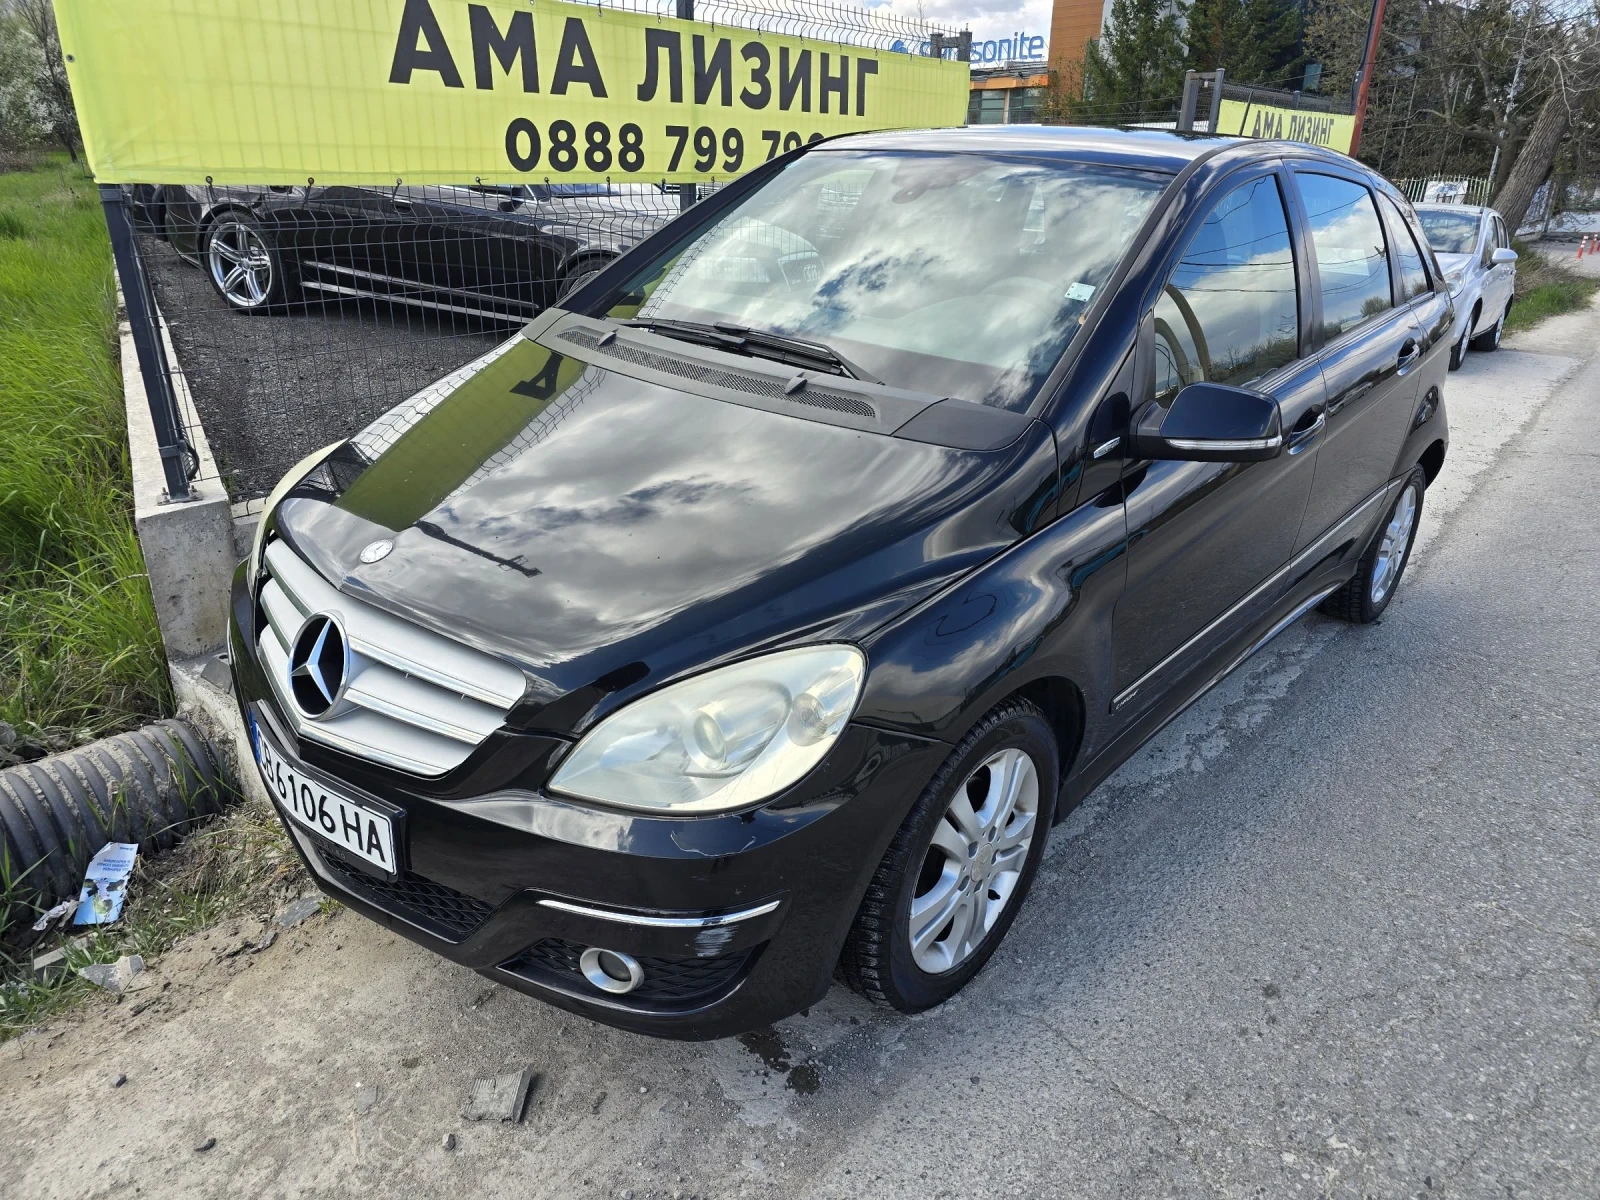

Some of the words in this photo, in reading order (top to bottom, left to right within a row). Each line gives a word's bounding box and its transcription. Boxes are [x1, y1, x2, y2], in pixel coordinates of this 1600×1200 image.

[388, 0, 608, 98] АМА
[637, 28, 879, 117] ЛИЗИНГ
[505, 117, 645, 172] 0888
[665, 125, 744, 172] 799
[1252, 110, 1282, 139] АМА
[1287, 115, 1334, 144] ЛИЗИНГ
